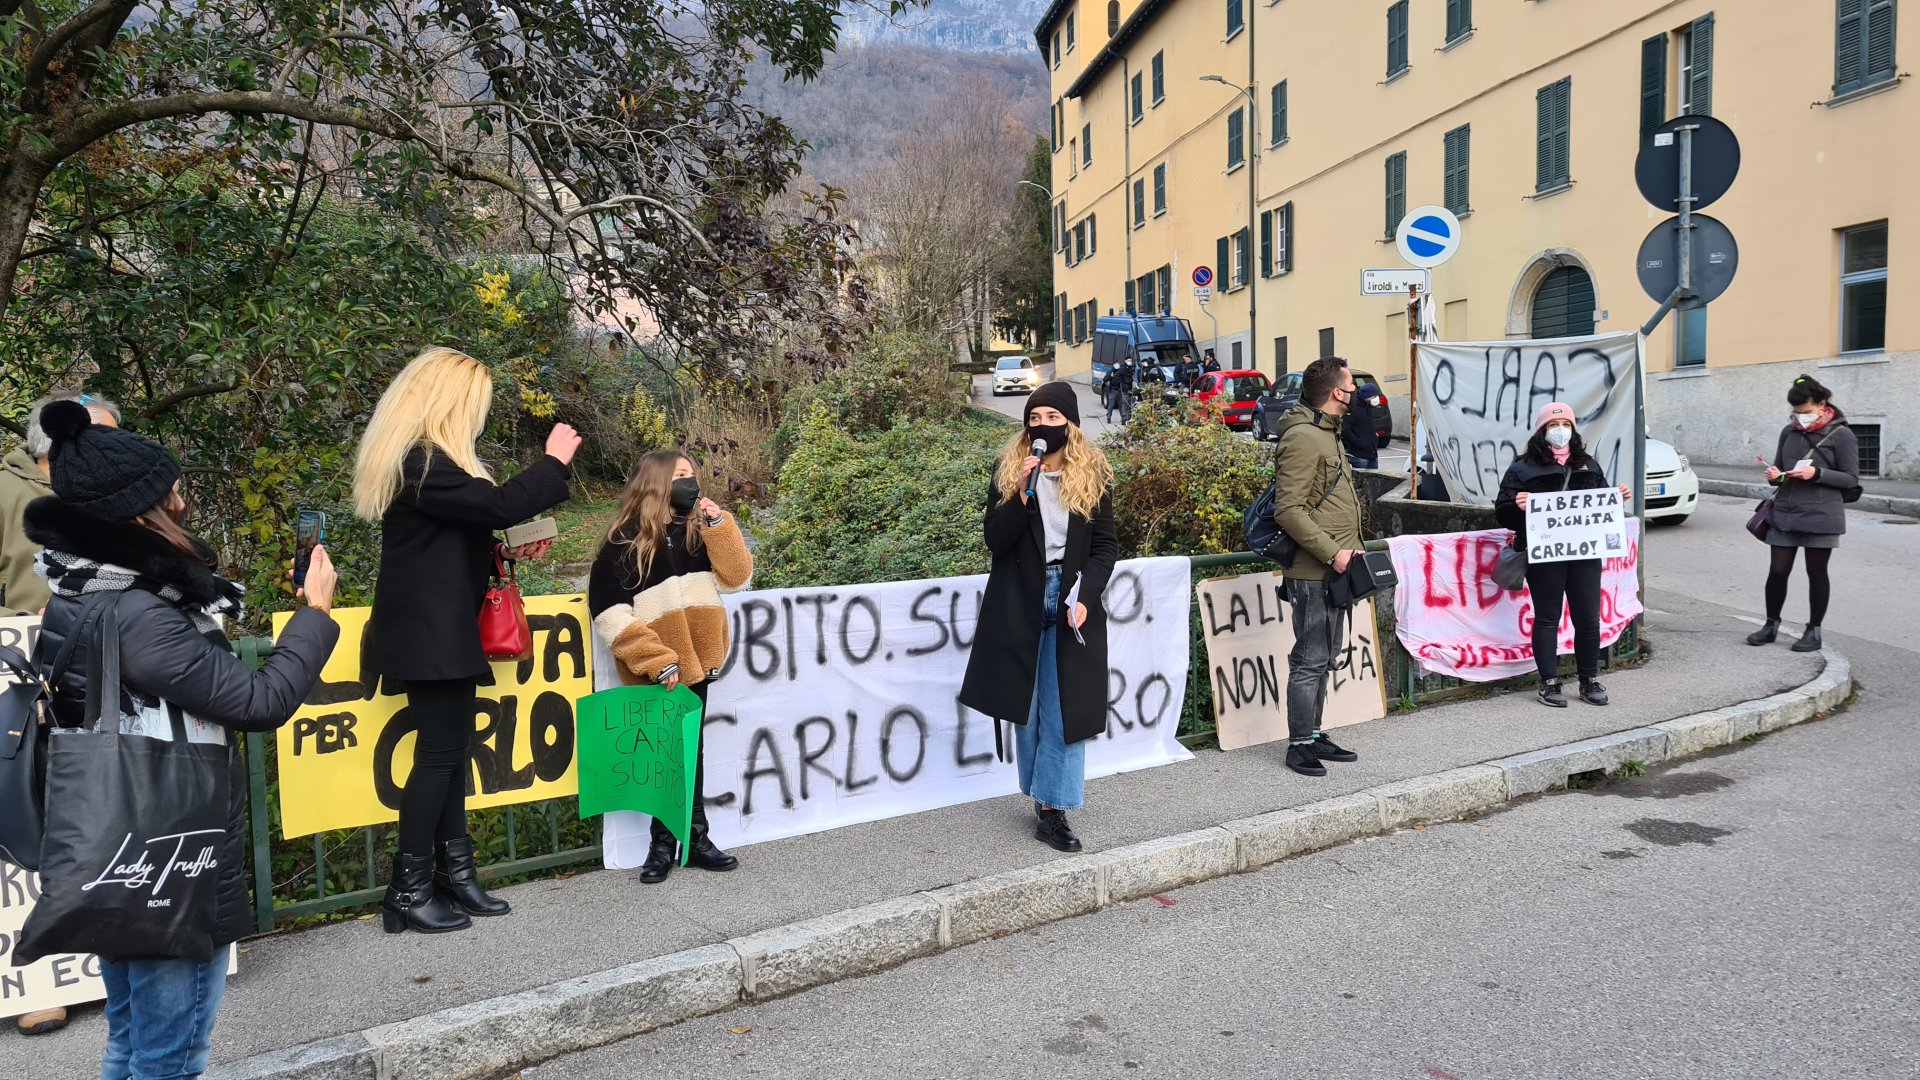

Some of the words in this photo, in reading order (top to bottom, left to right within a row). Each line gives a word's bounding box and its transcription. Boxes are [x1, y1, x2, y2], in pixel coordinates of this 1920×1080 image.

[1367, 281, 1392, 291] Airoldi
[1530, 539, 1599, 560] CARLO!
[1203, 591, 1251, 637] LA
[1215, 654, 1280, 716] NON
[293, 711, 358, 757] PER
[372, 690, 575, 811] CRLO
[81, 832, 155, 891] Lady
[145, 829, 226, 895] Truffle
[147, 898, 172, 908] ROME
